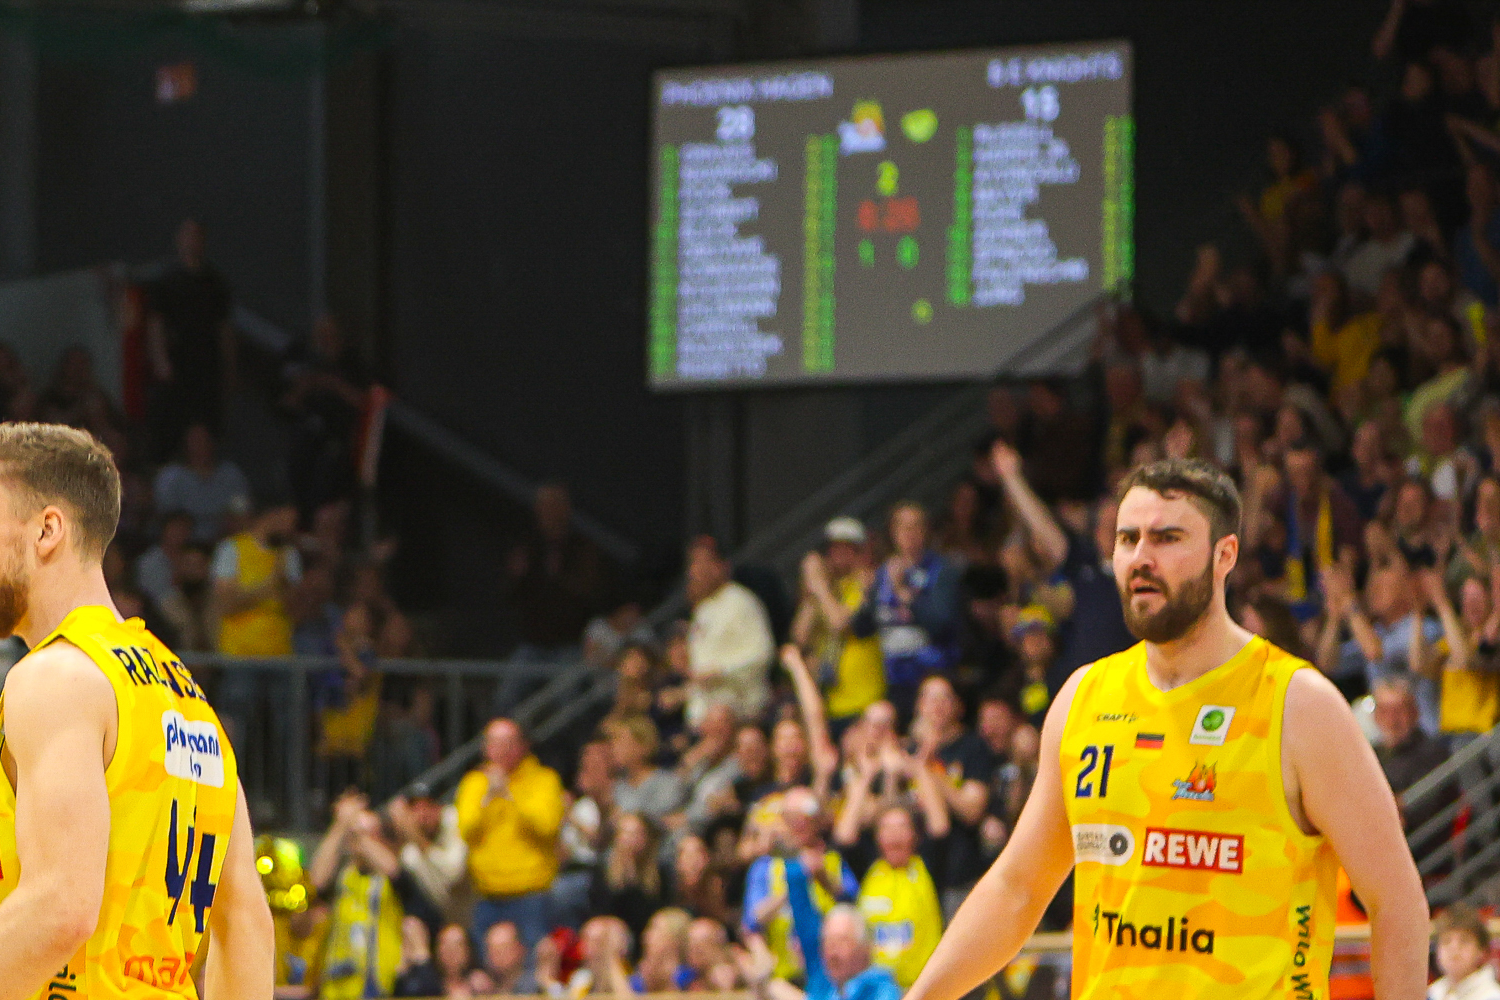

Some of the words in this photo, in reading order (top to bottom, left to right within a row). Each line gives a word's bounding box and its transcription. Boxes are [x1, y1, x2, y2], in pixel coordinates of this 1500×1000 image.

[1075, 744, 1115, 798] 21
[1145, 831, 1240, 871] REWE
[1102, 910, 1215, 955] Thalia
